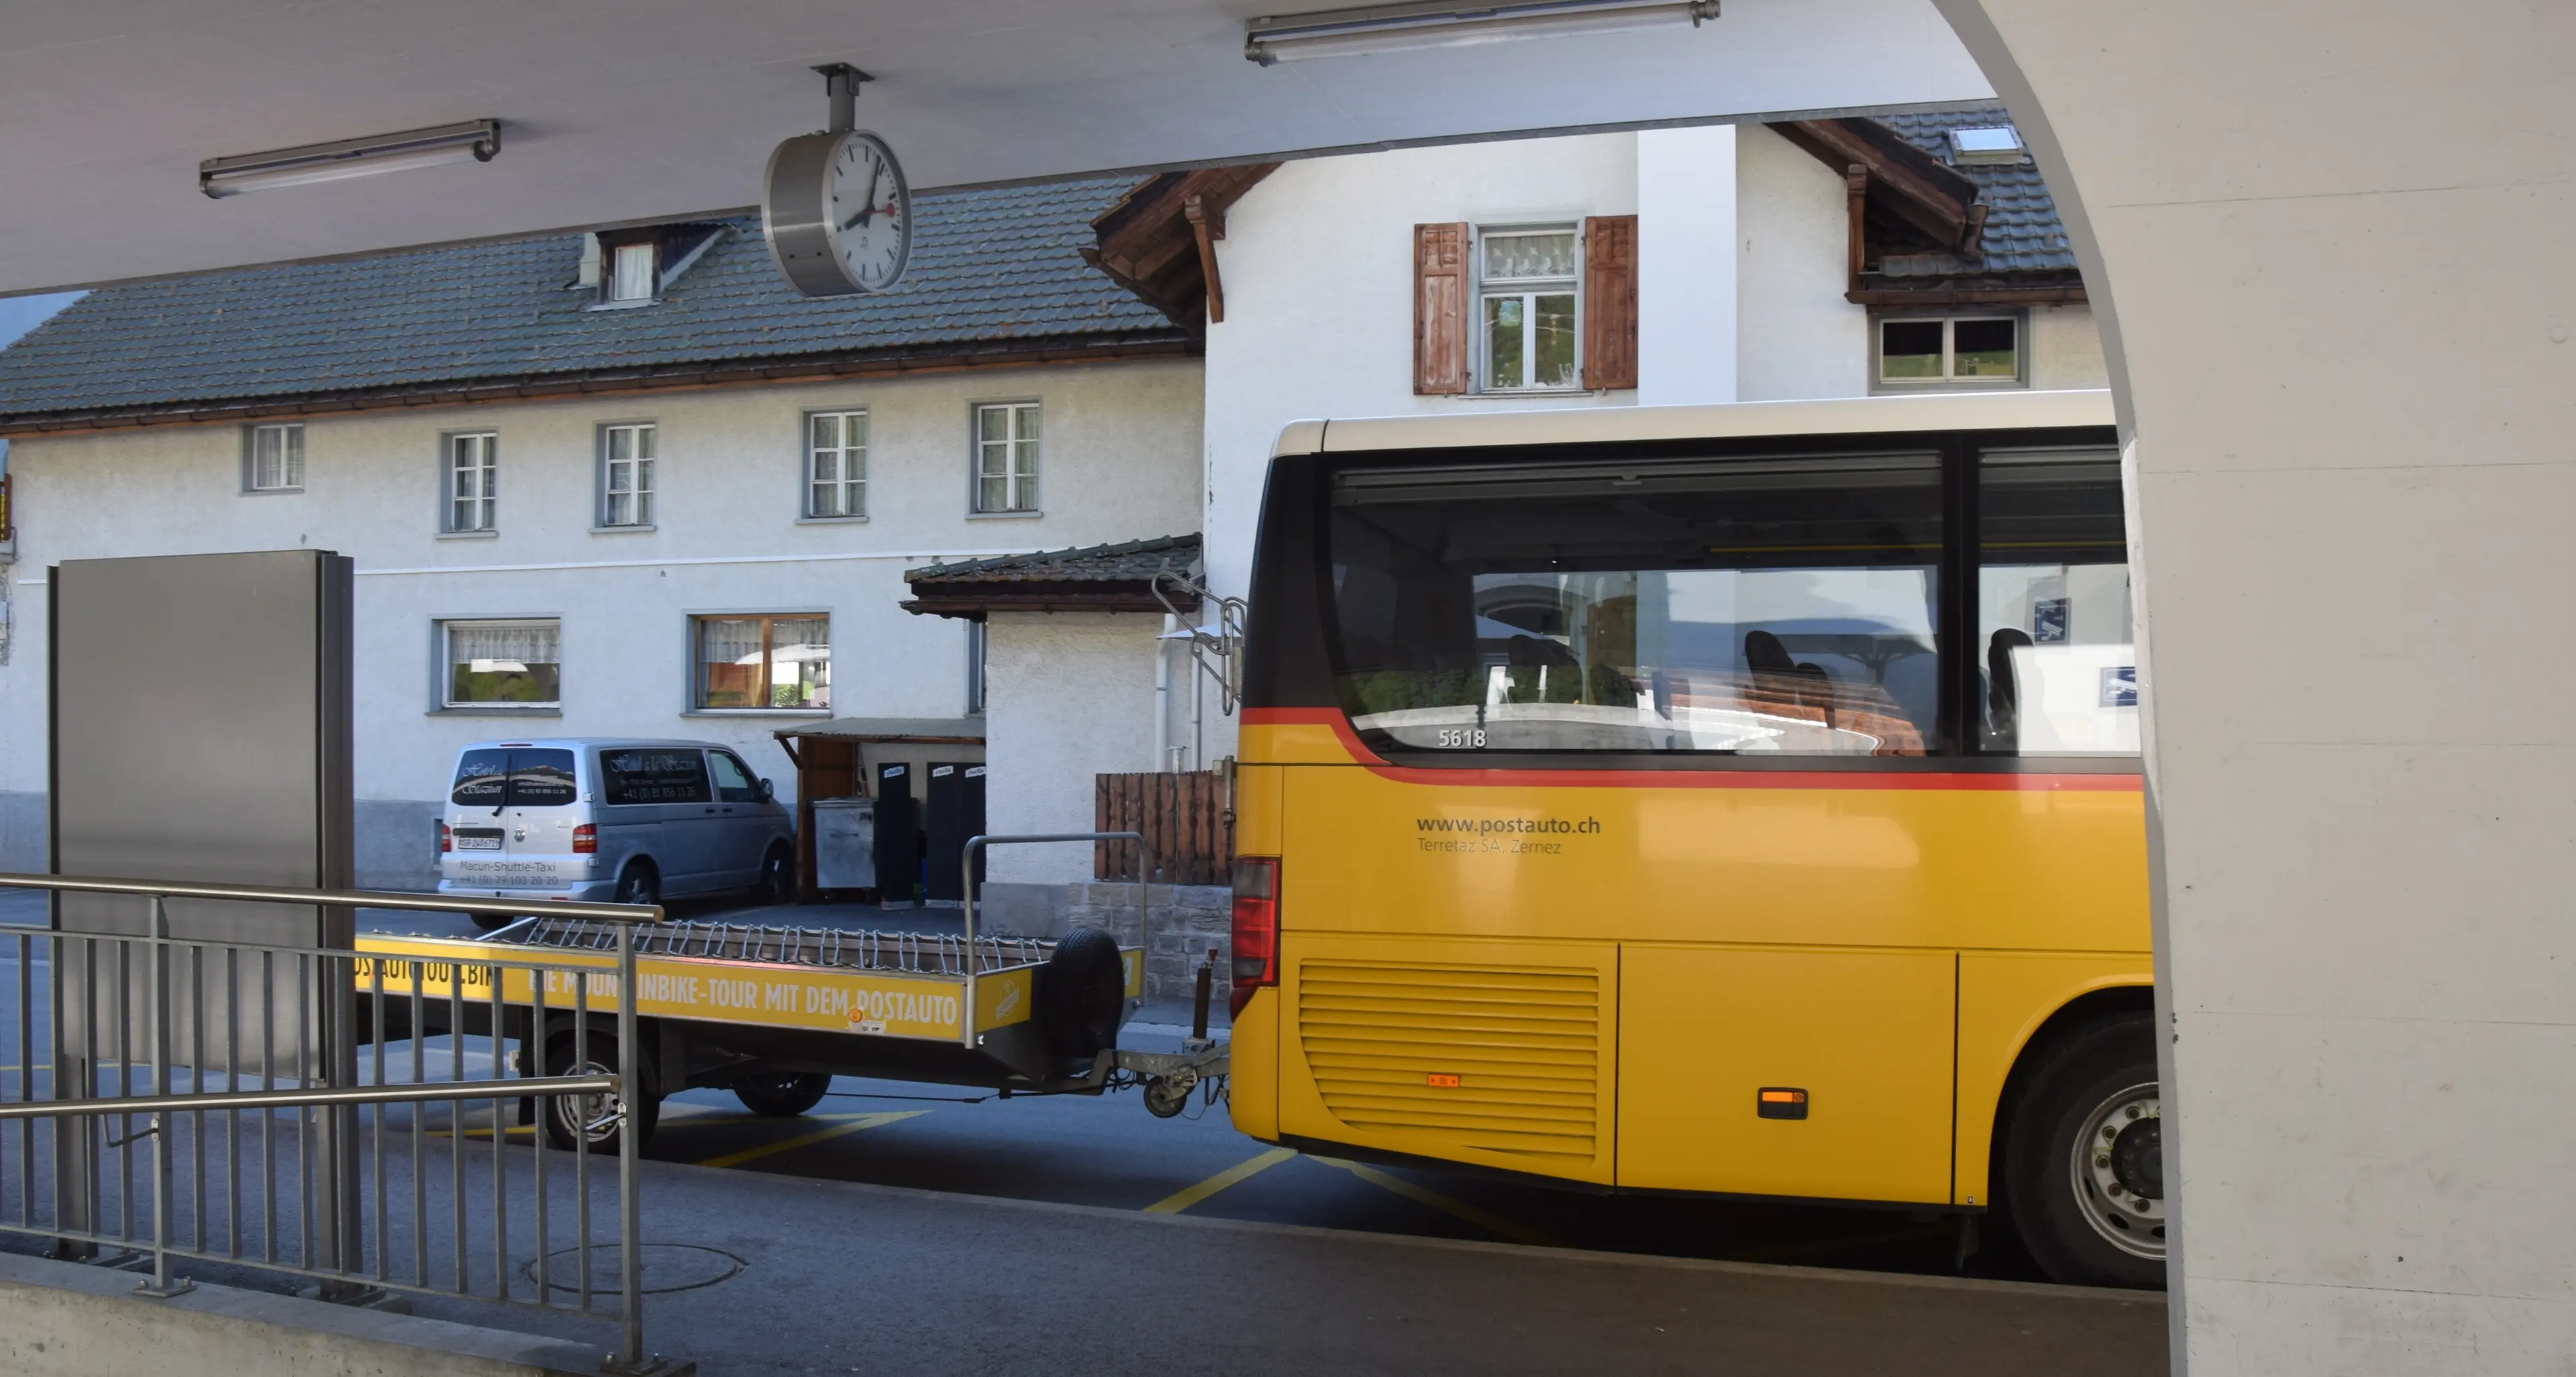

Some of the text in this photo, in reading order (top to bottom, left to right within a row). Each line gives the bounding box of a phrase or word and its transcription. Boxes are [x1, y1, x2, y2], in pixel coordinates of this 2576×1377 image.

[1439, 730, 1487, 747] 5618
[623, 788, 637, 799] +41
[639, 787, 651, 800] (0)
[1417, 816, 1601, 836] www.postauto.ch
[1417, 838, 1562, 855] Terretaz SA, Zernez
[460, 861, 556, 872] Macun-Shuttle-Taxi
[461, 875, 558, 885] +41 (0) 79 103 20 20
[765, 983, 800, 1012] MIT
[806, 986, 848, 1016] DEM
[857, 989, 957, 1026] POSTAUTO
